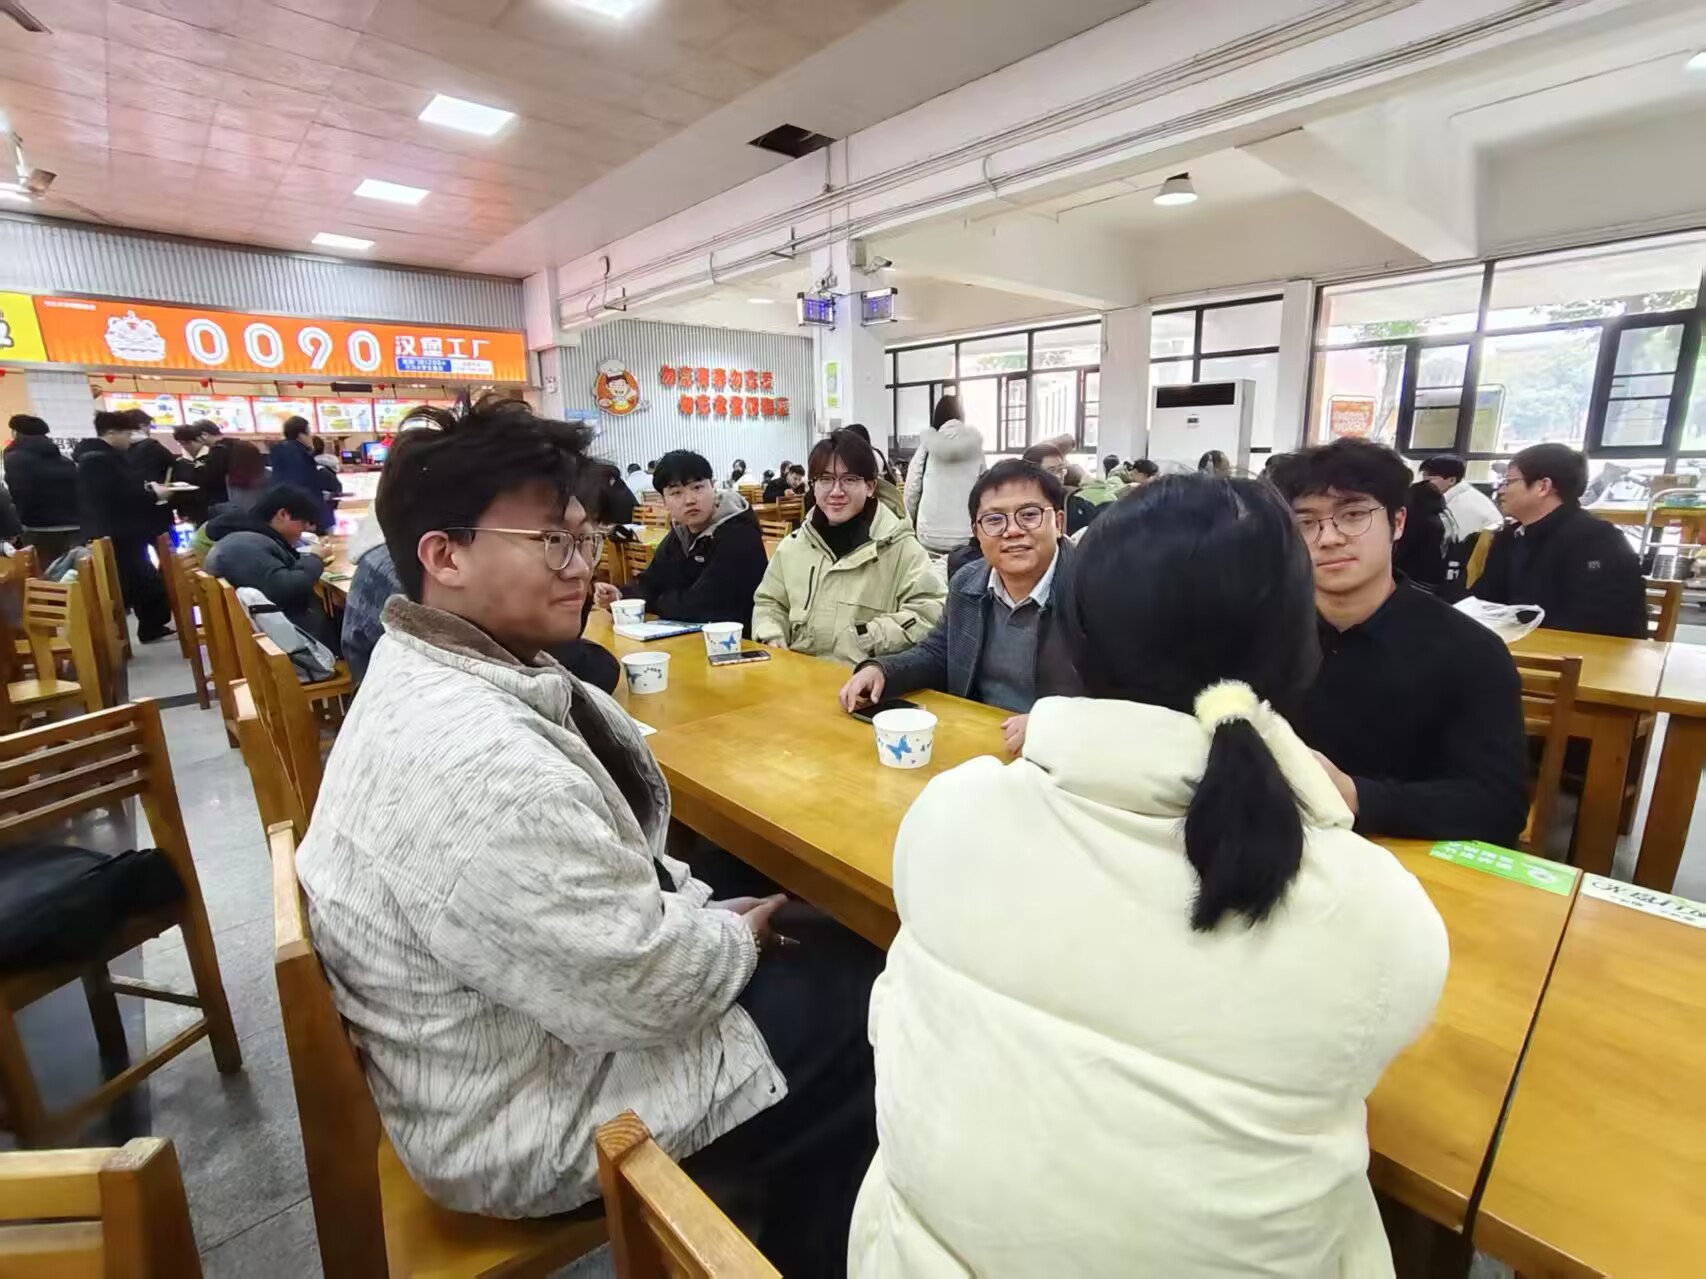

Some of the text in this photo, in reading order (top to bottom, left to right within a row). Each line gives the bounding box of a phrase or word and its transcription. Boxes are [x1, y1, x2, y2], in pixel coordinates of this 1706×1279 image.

[185, 318, 382, 372] 0090
[394, 335, 490, 358] 汉堡工厂
